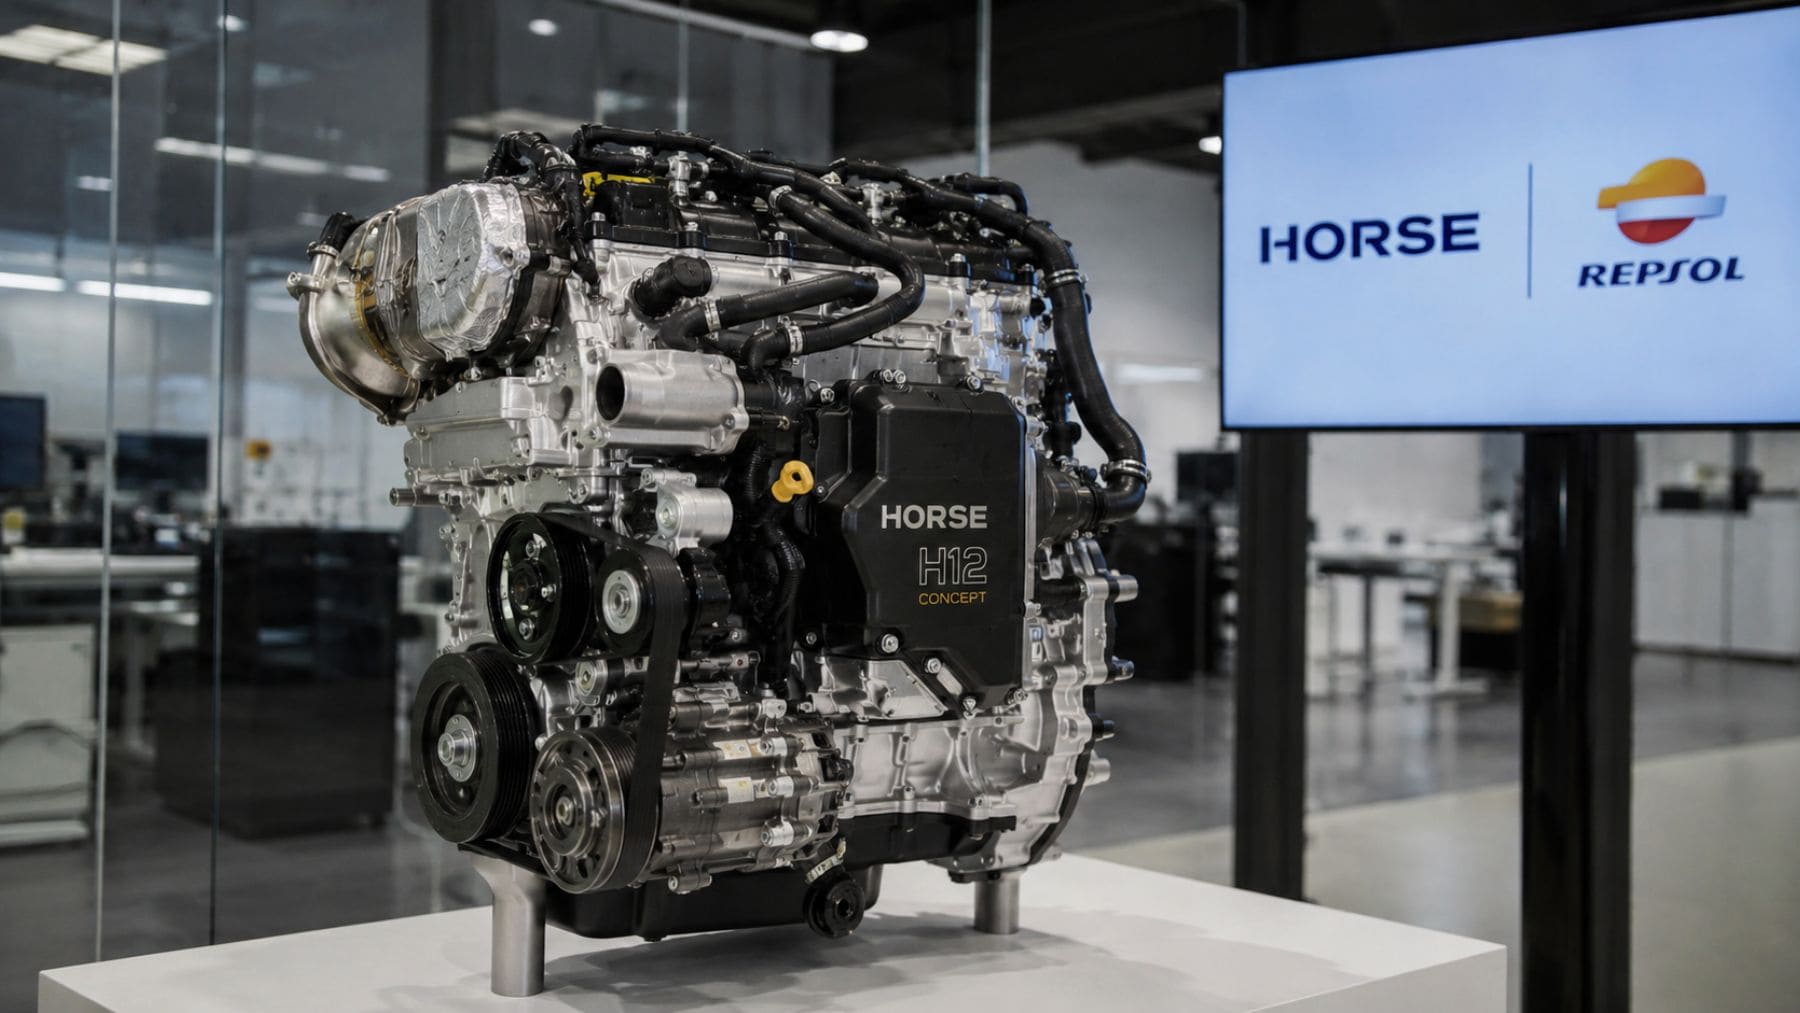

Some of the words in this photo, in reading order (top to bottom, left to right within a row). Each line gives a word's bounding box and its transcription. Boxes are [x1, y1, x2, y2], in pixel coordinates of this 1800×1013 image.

[1260, 211, 1481, 265] HORSE
[1577, 256, 1745, 288] REPSOL
[881, 504, 988, 530] HORSE
[918, 546, 988, 586] H12
[918, 591, 987, 606] CONCEPT
